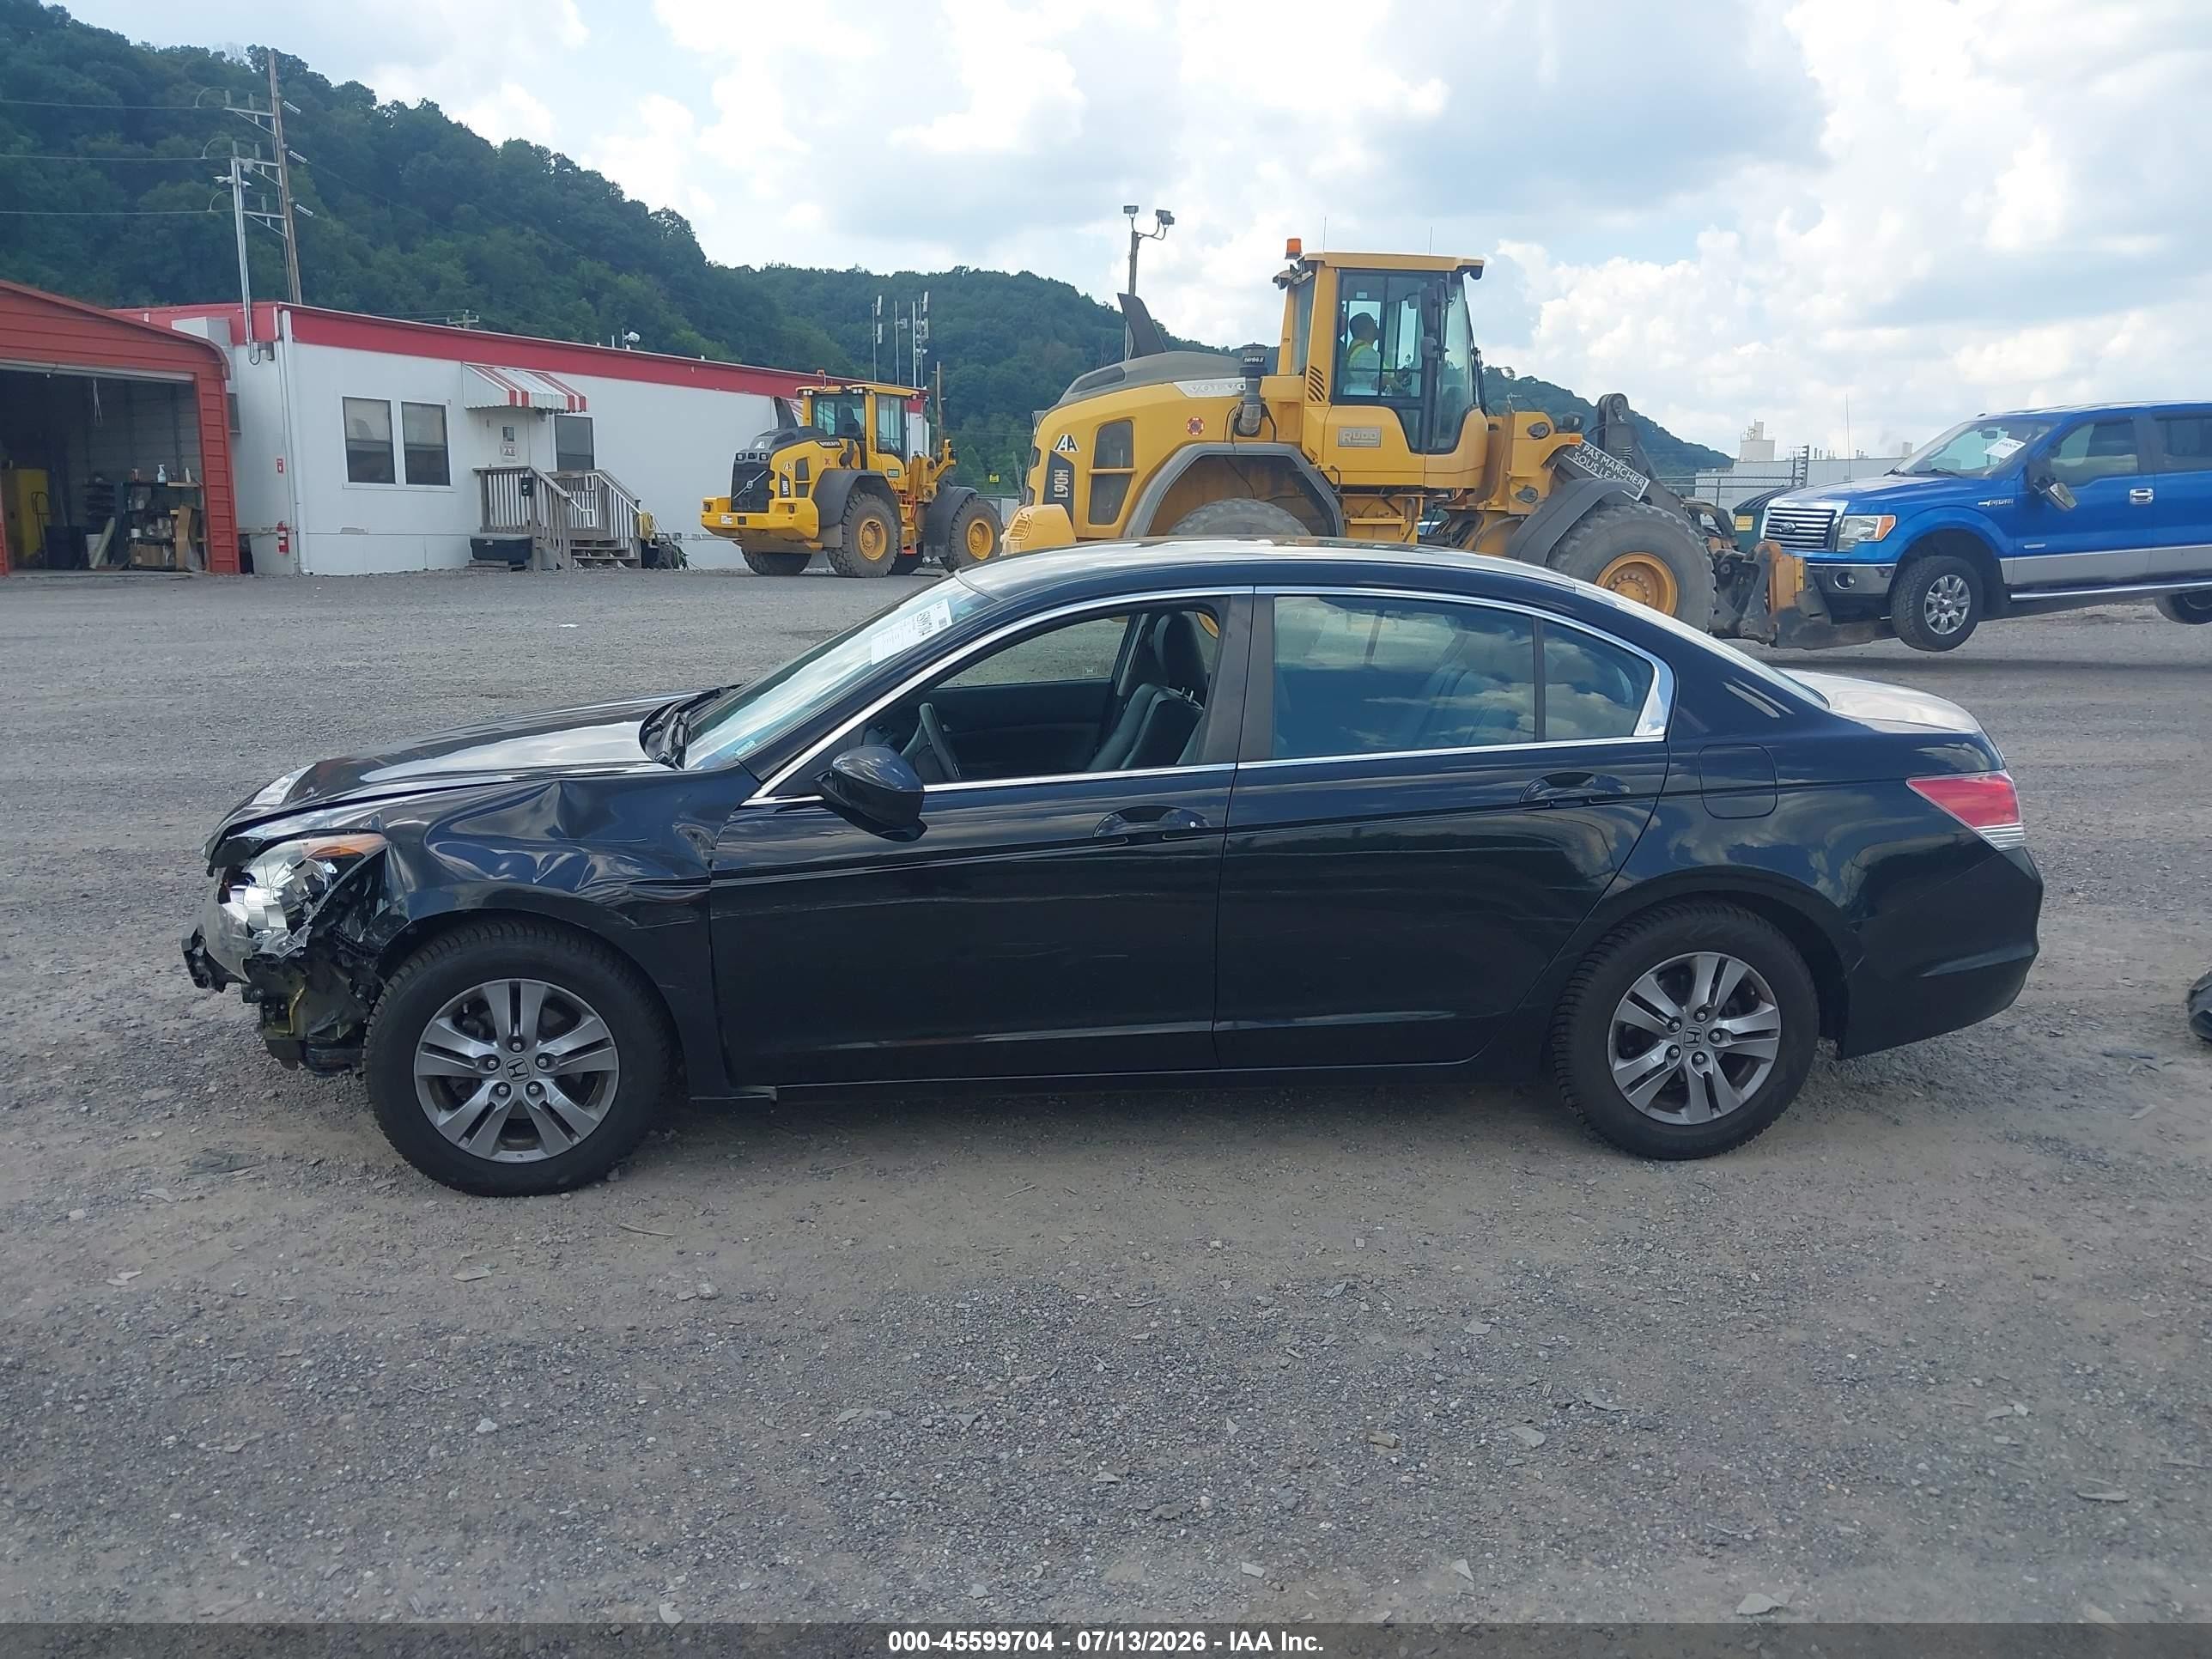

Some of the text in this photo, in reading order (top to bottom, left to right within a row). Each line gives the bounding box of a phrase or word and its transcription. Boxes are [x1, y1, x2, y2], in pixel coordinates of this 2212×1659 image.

[1573, 452, 1599, 471] SOUS
[1598, 467, 1612, 479] LE
[1583, 445, 1644, 489] PAS MARCHER
[1054, 469, 1069, 498] L90H
